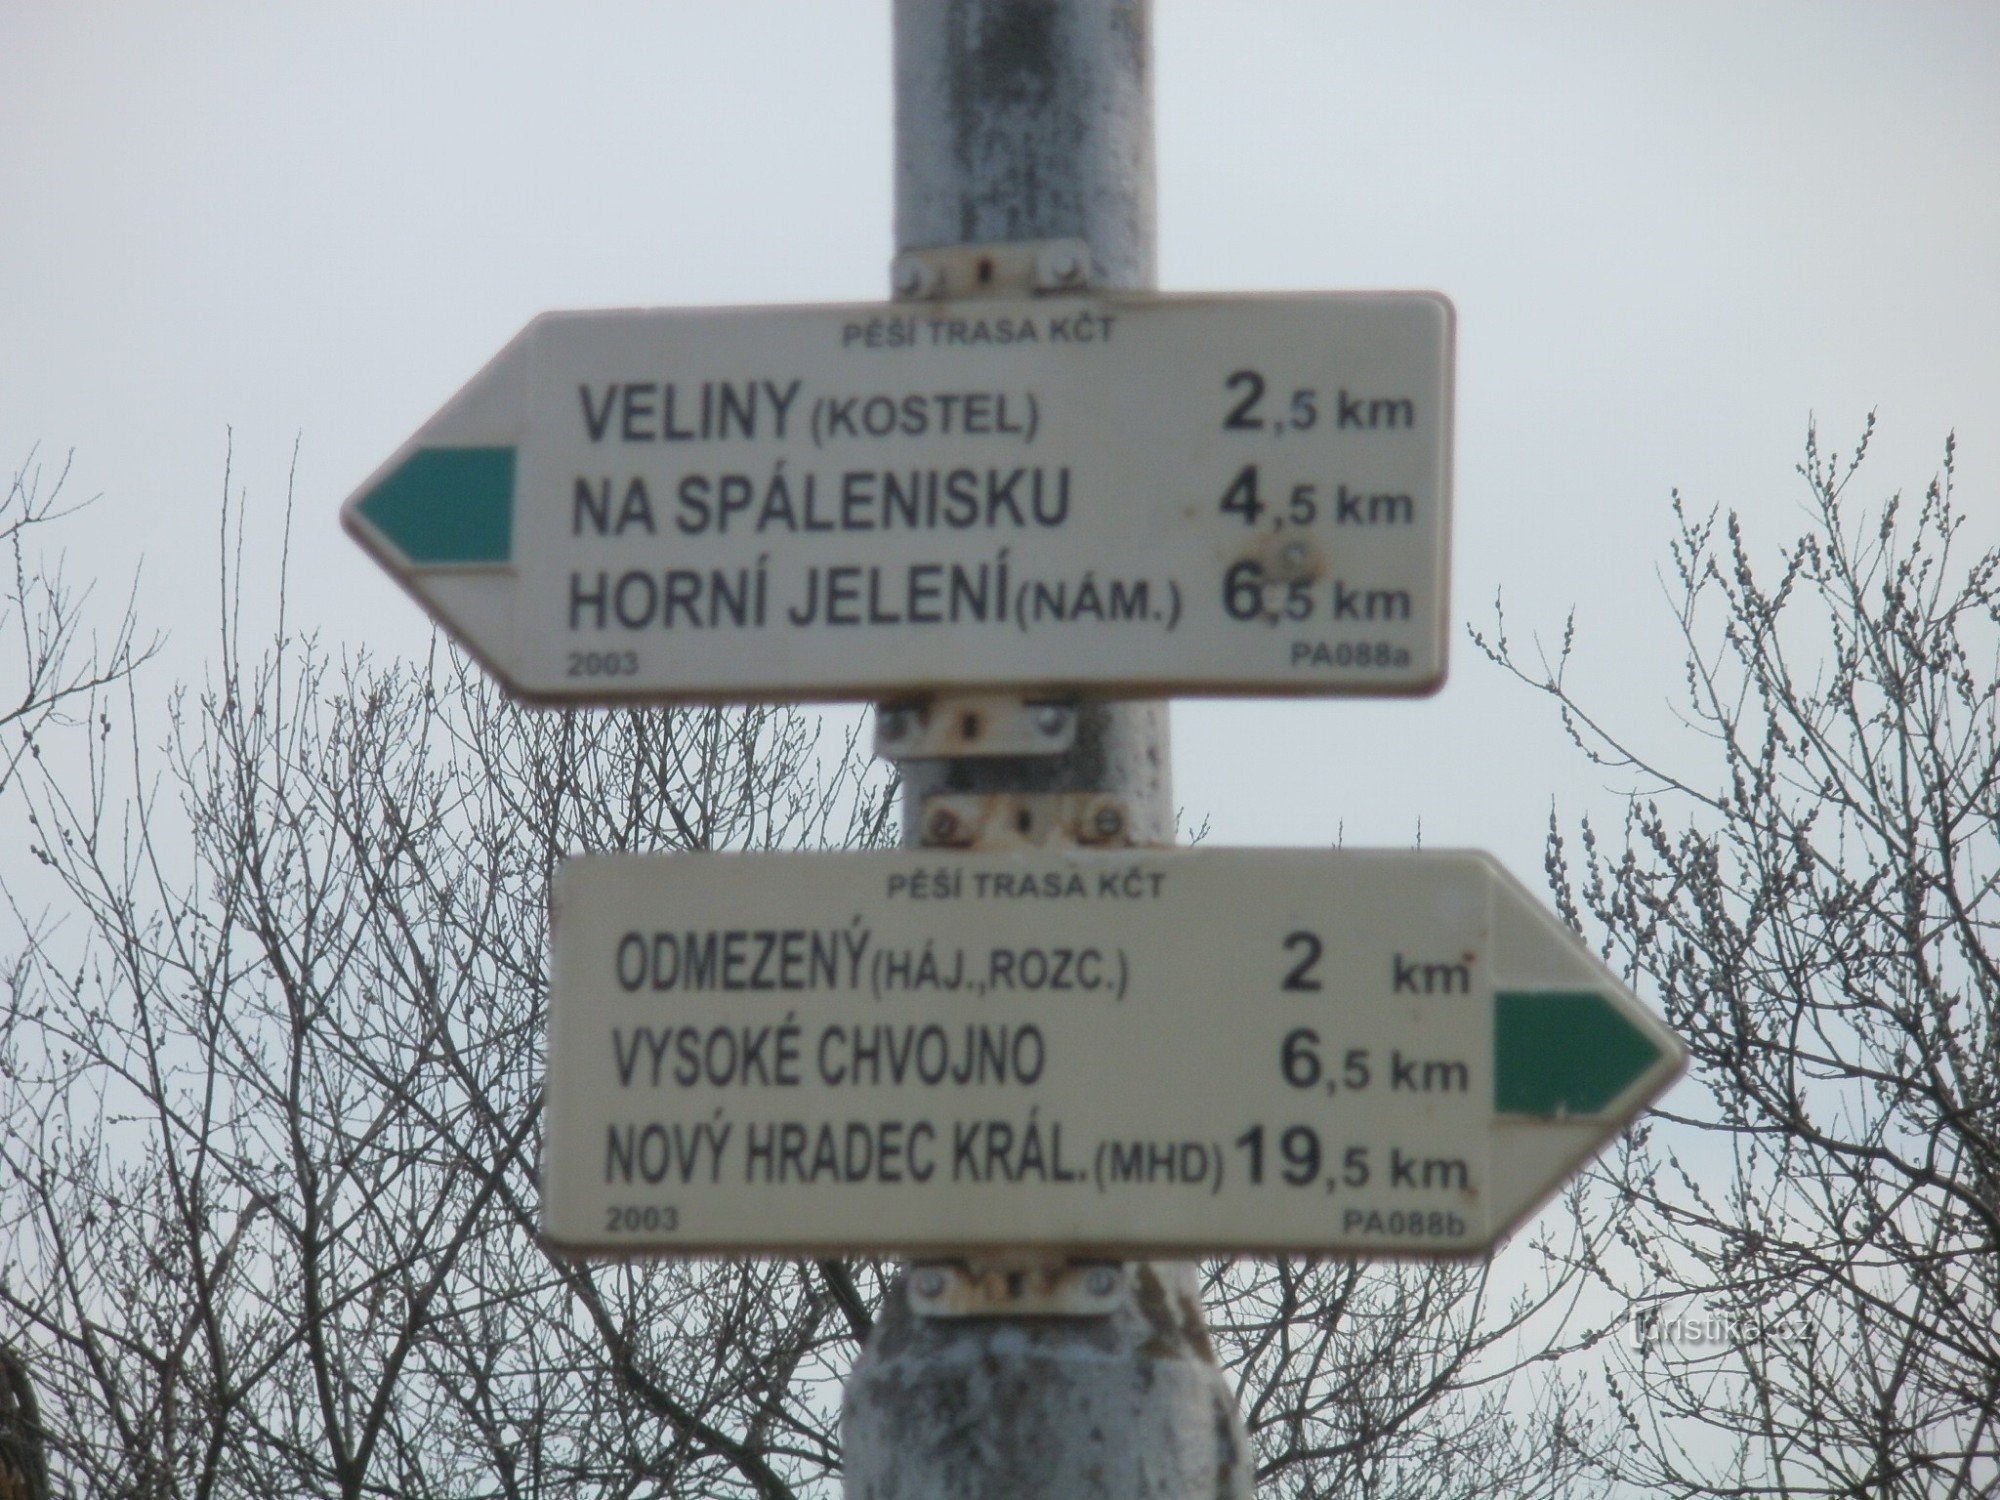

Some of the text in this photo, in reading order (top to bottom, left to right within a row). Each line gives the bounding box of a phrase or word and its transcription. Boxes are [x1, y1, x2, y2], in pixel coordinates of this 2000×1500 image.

[843, 312, 1117, 348] PĚŠÍ TRASA KČT
[578, 370, 1416, 447] VELINY (KOSTEL) 2,5 km
[572, 459, 1415, 536] NA SPÁLENISKU 4,5 km
[568, 554, 768, 631] HORNÍ
[1222, 559, 1315, 628] 6,5
[1333, 582, 1412, 620] km
[567, 652, 639, 676] 2003
[1291, 643, 1411, 668] PA088a
[887, 868, 1166, 900] PĚŠÍ TRASA KČT
[1281, 930, 1323, 991] 2
[1393, 955, 1471, 994] km
[612, 1010, 1469, 1096] VYSOKÉ CHVOJNO 6,5 km
[605, 1106, 732, 1186] NOVÝ
[746, 1119, 936, 1184] HRADEC
[1094, 1140, 1223, 1196] (MHD)
[1235, 1123, 1370, 1193] 19,5
[1390, 1149, 1469, 1189] km
[605, 1205, 680, 1232] 2003
[1342, 1208, 1466, 1237] PA088b
